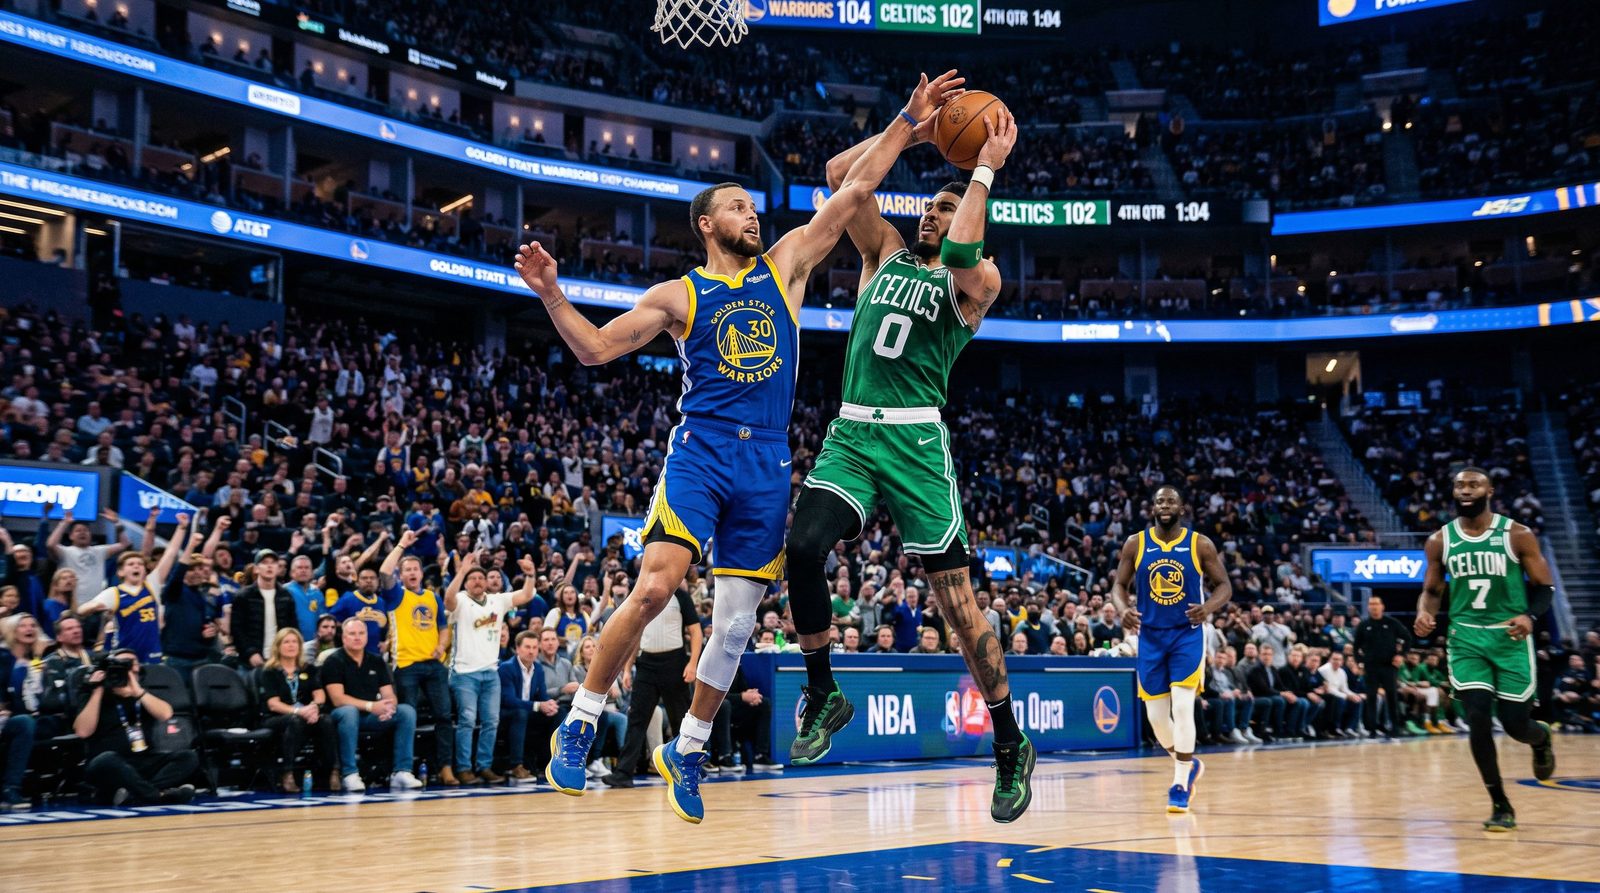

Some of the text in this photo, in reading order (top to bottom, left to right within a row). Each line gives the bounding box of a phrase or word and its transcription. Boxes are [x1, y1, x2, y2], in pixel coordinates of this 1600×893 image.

[768, 1, 871, 24] WARRIORS 104
[880, 3, 974, 28] CELTICS 102
[983, 8, 1061, 28] 4TH QTR 1:04
[465, 146, 508, 167] GOLDEN
[508, 157, 540, 174] STATE
[992, 201, 1096, 225] CELTICS 102
[1118, 202, 1210, 221] 4TH QTR 1:04
[233, 218, 271, 238] AT&T
[430, 259, 473, 278] GOLDEN
[475, 268, 506, 285] STATE
[870, 273, 944, 322] CELTICS
[711, 299, 776, 324] GOLDEN STATE
[747, 319, 771, 339] 30
[872, 312, 913, 359] 0
[717, 355, 783, 383] WARRIORS
[1167, 571, 1181, 582] 30
[1448, 551, 1507, 578] CELTON
[1468, 578, 1491, 609] 7
[867, 694, 917, 736] NBA
